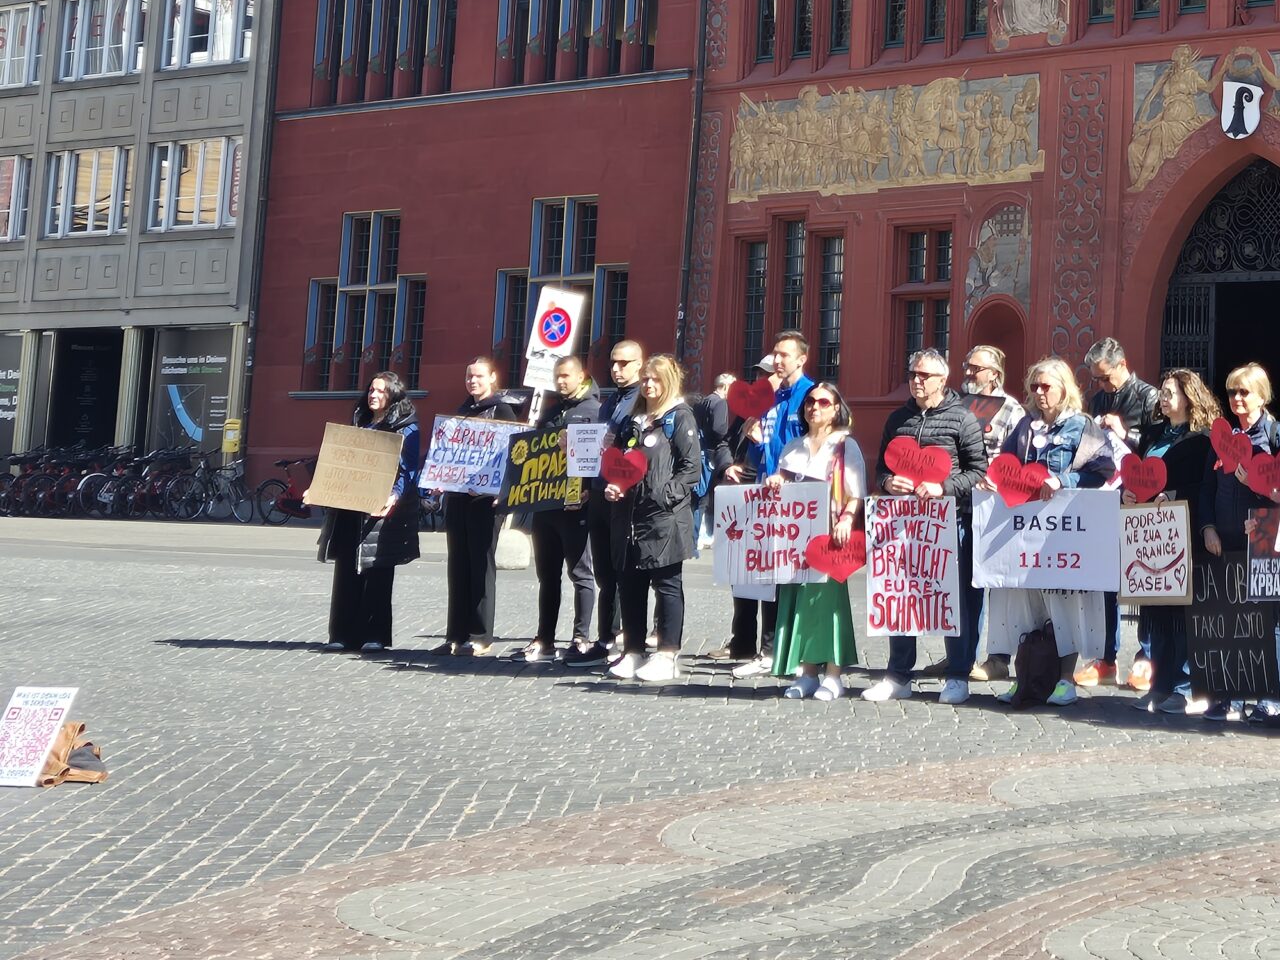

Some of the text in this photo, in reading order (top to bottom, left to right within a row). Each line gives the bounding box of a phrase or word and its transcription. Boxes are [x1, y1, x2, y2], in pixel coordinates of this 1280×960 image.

[448, 427, 496, 448] ДРАГИ
[433, 447, 504, 468] СТУДЕНТИ
[744, 486, 782, 503] IHRE
[757, 501, 818, 519] HÄNDE
[753, 523, 800, 540] SIND
[1013, 515, 1086, 531] BASEL
[874, 520, 947, 545] DIE WELT
[1126, 530, 1138, 545] NE
[1136, 542, 1177, 560] GRANICE
[872, 541, 952, 580] BRAUCHT
[1019, 552, 1081, 569] 11:52
[1251, 558, 1270, 573] РУКЕ
[1271, 558, 1280, 573] СУ
[1225, 563, 1258, 604] ОВ
[1192, 612, 1264, 639] ТАКО ДУГО
